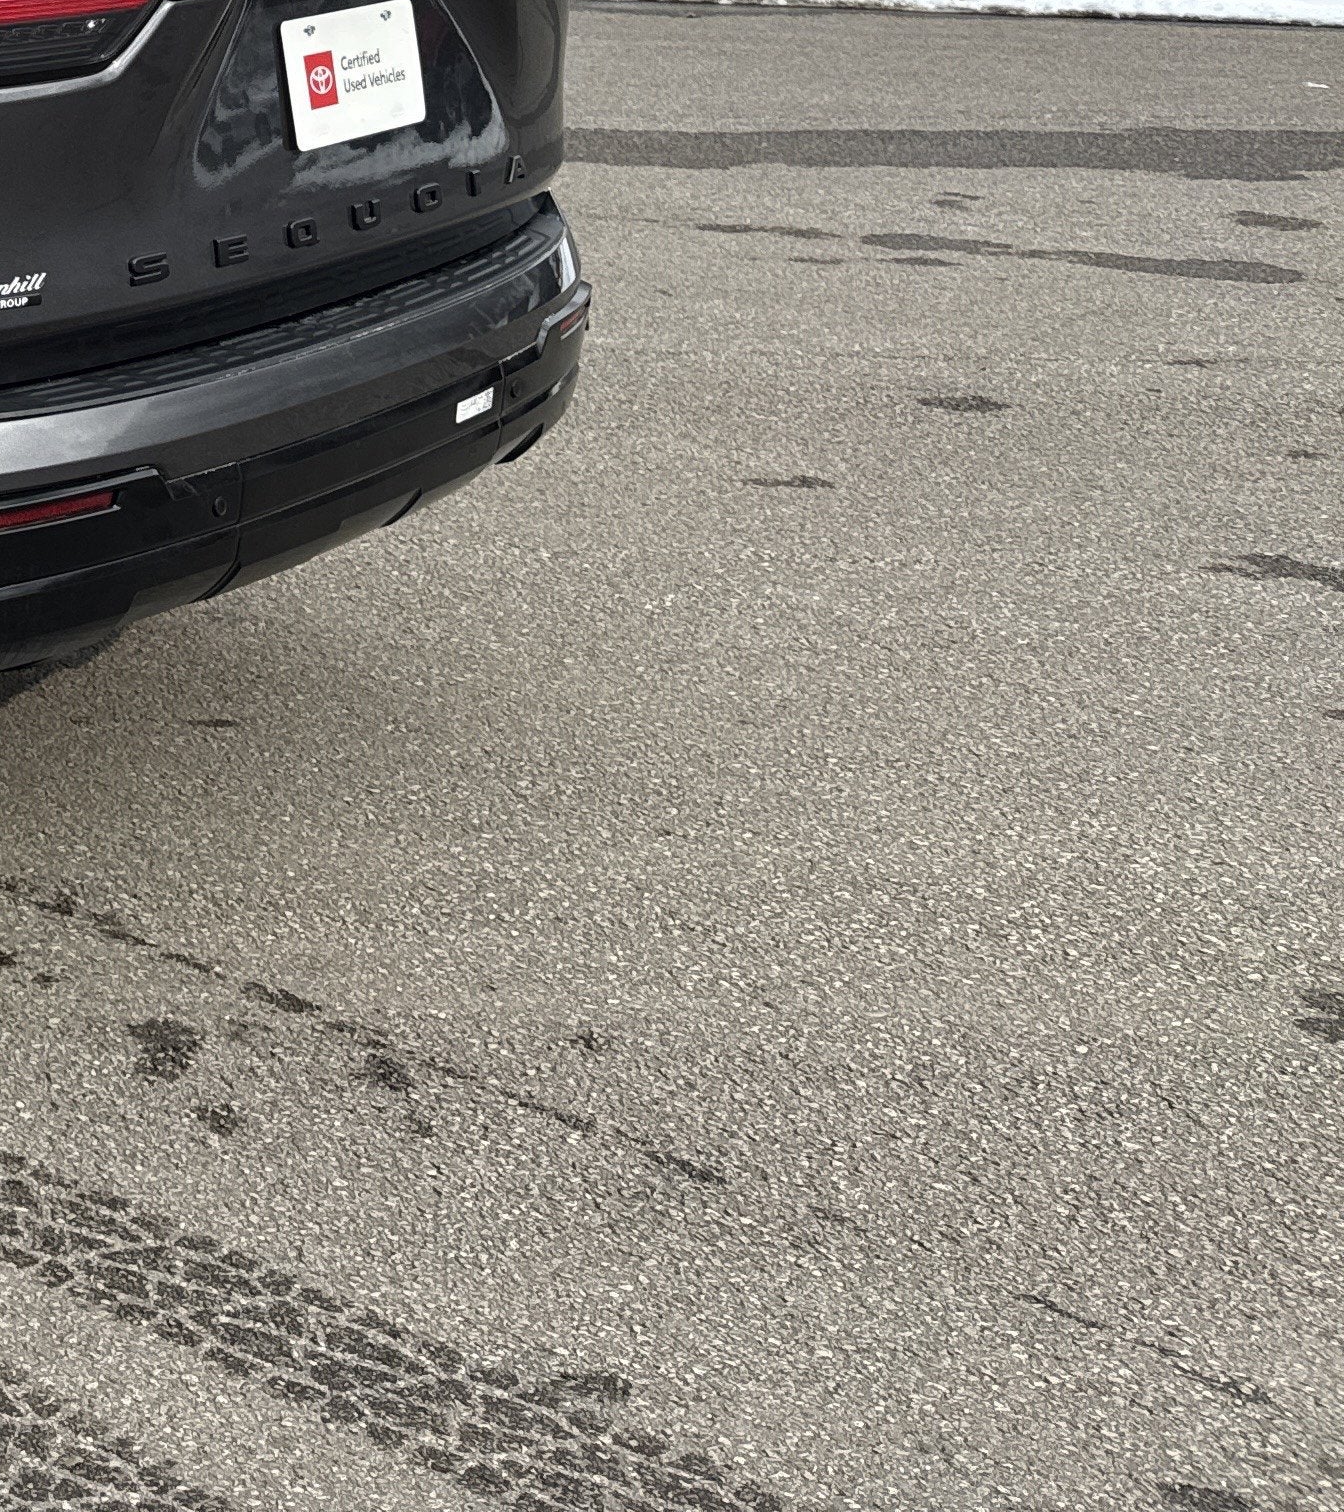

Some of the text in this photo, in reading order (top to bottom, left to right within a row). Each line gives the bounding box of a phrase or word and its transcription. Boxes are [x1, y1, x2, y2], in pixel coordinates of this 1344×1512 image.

[341, 48, 381, 71] Certified
[343, 67, 406, 93] Used Vehicles
[127, 154, 529, 287] SEQUOIA
